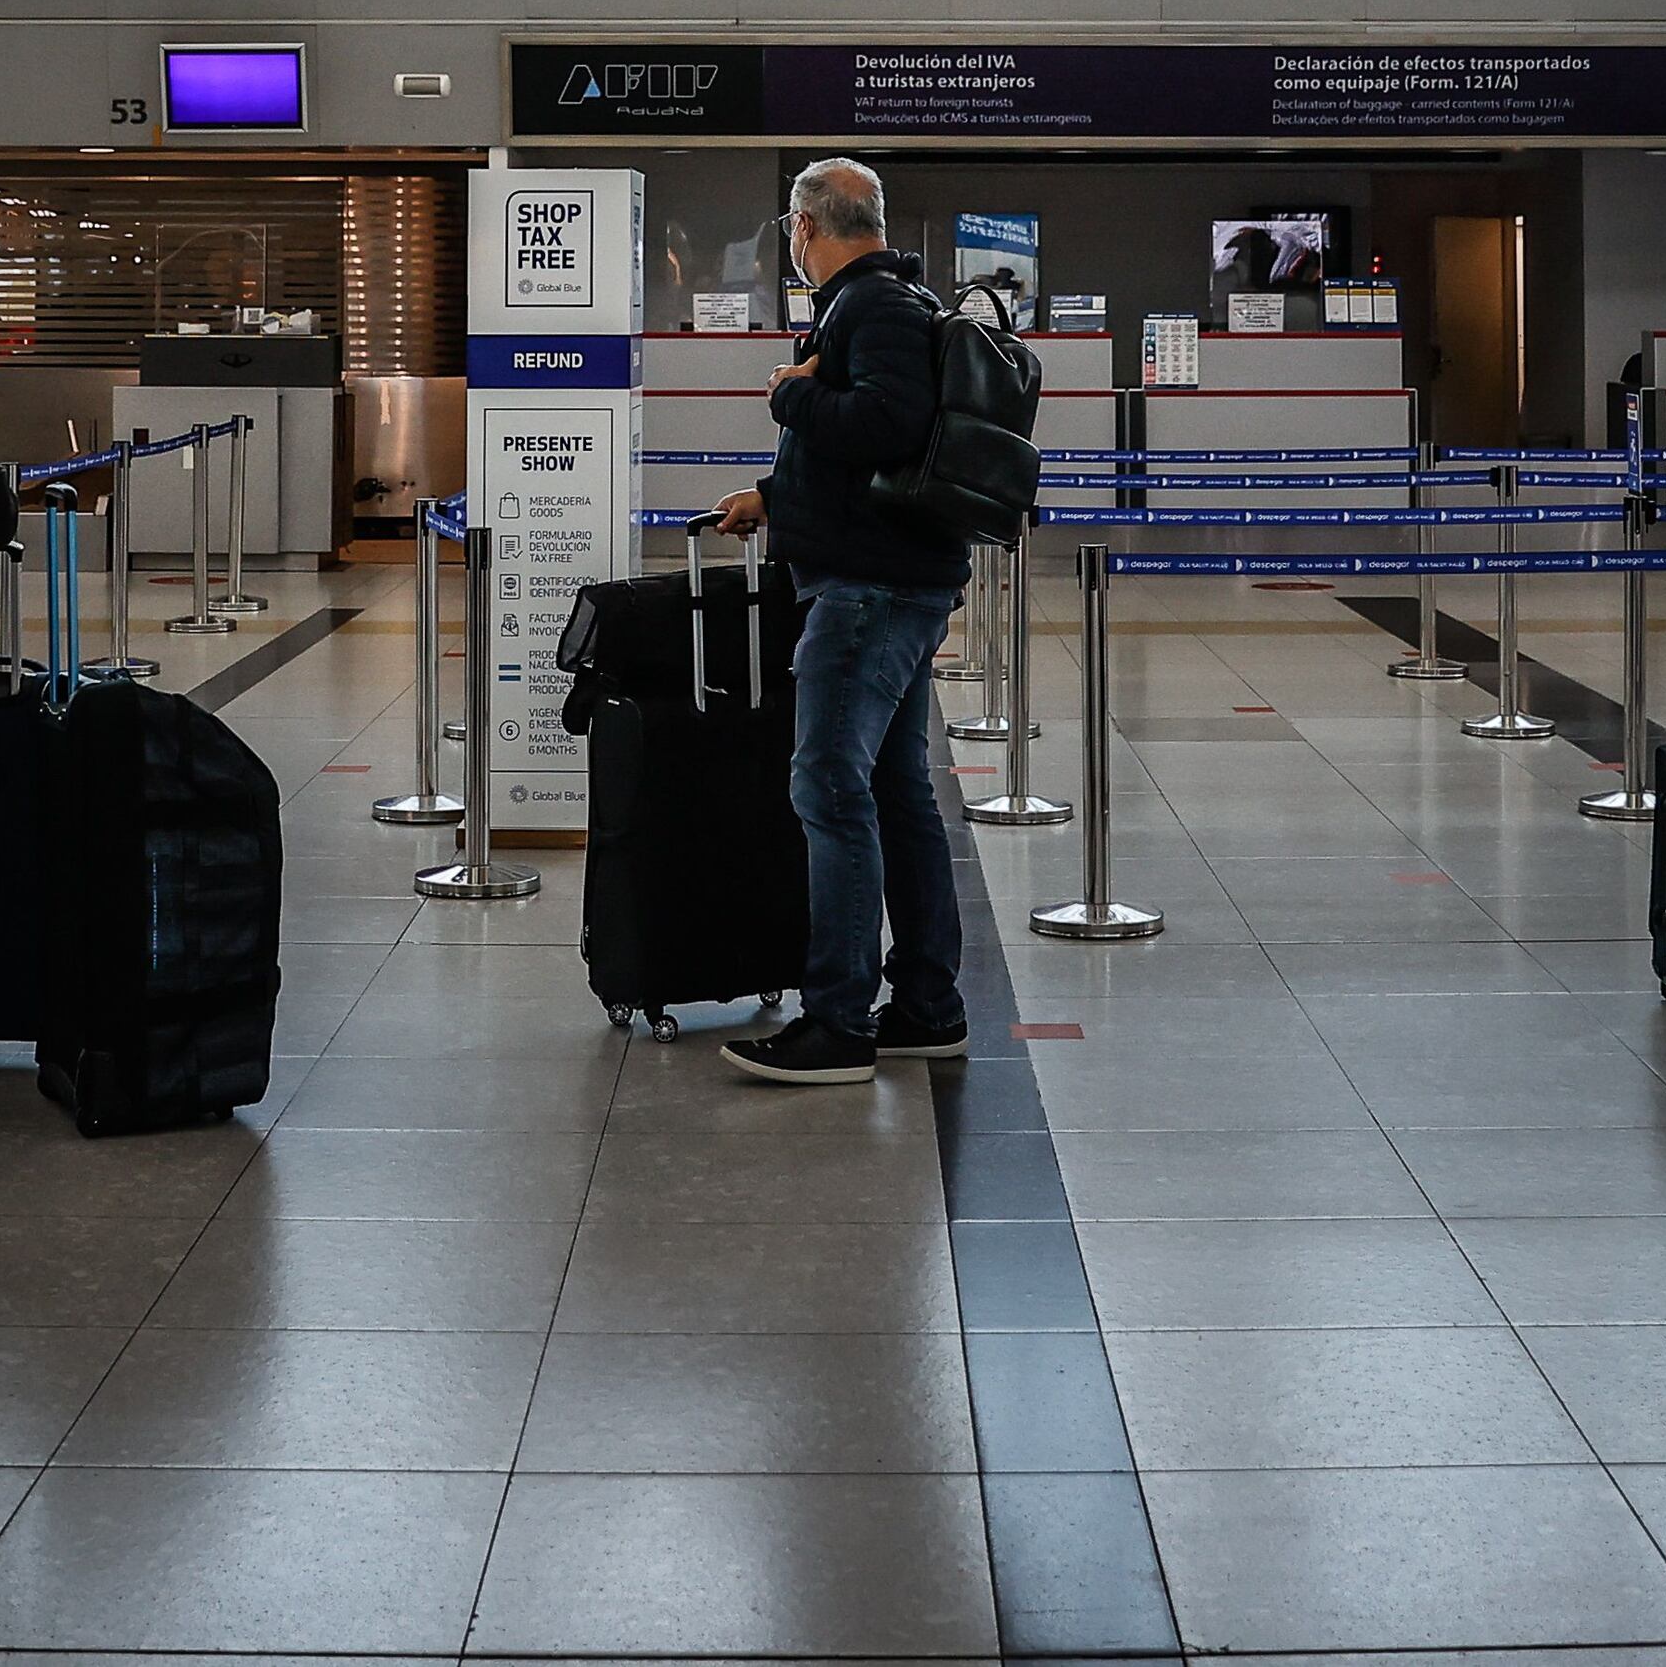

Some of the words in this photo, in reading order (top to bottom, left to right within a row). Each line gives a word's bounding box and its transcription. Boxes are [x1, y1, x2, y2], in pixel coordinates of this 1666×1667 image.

[855, 53, 951, 69] Devolución
[956, 53, 982, 69] del
[987, 54, 1016, 69] IVA
[1274, 55, 1375, 71] Declaración
[1379, 55, 1400, 71] de
[1404, 55, 1465, 71] efectos
[1469, 56, 1590, 74] transportados
[558, 64, 719, 105] AFIP
[854, 76, 865, 89] a
[869, 74, 933, 89] turistas
[937, 74, 1036, 92] extranjeros
[1274, 77, 1321, 90] como
[1325, 74, 1400, 93] equipaje
[1404, 74, 1459, 92] (Form.
[1464, 74, 1519, 92] 121/A)
[854, 97, 875, 108] VAT
[877, 97, 912, 108] return
[915, 97, 926, 108] to
[929, 97, 970, 108] foreign
[972, 97, 1014, 108] tourists
[1272, 99, 1337, 111] Declaration
[1340, 99, 1351, 111] of
[1353, 99, 1403, 111] baggage
[1411, 99, 1450, 111] carried
[1452, 99, 1500, 111] contents
[110, 99, 148, 124] 53
[922, 113, 937, 125] do
[940, 113, 968, 125] ICMS
[970, 113, 977, 125] a
[979, 113, 1020, 125] turistas
[1022, 113, 1092, 125] estrangeiros
[1340, 113, 1356, 126] de
[1398, 113, 1475, 126] transportados
[1478, 113, 1509, 126] como
[1512, 113, 1564, 126] bagagem
[517, 203, 582, 224] SHOP
[517, 227, 563, 246] TAX
[517, 250, 575, 269] FREE
[536, 283, 562, 293] Global
[564, 283, 582, 293] Blue
[513, 352, 584, 369] REFUND
[503, 436, 593, 451] PRESENTE
[521, 456, 575, 471] SHOW
[529, 508, 564, 518] GOODS
[529, 530, 592, 540] FORMULARIO
[529, 553, 547, 563] TAX
[548, 553, 573, 563] FREE
[529, 588, 578, 598] IDENTIFICA
[529, 675, 574, 684] NATIONAL
[529, 685, 569, 694] PRODUC
[528, 708, 563, 718] VIGENC
[528, 719, 535, 729] 6
[536, 719, 563, 729] MESE
[505, 725, 514, 736] 6
[528, 734, 550, 744] MAX
[552, 734, 574, 744] TIME
[528, 745, 535, 755] 6
[536, 745, 578, 755] MONTHS
[532, 791, 562, 801] Global
[564, 791, 587, 801] Blue
